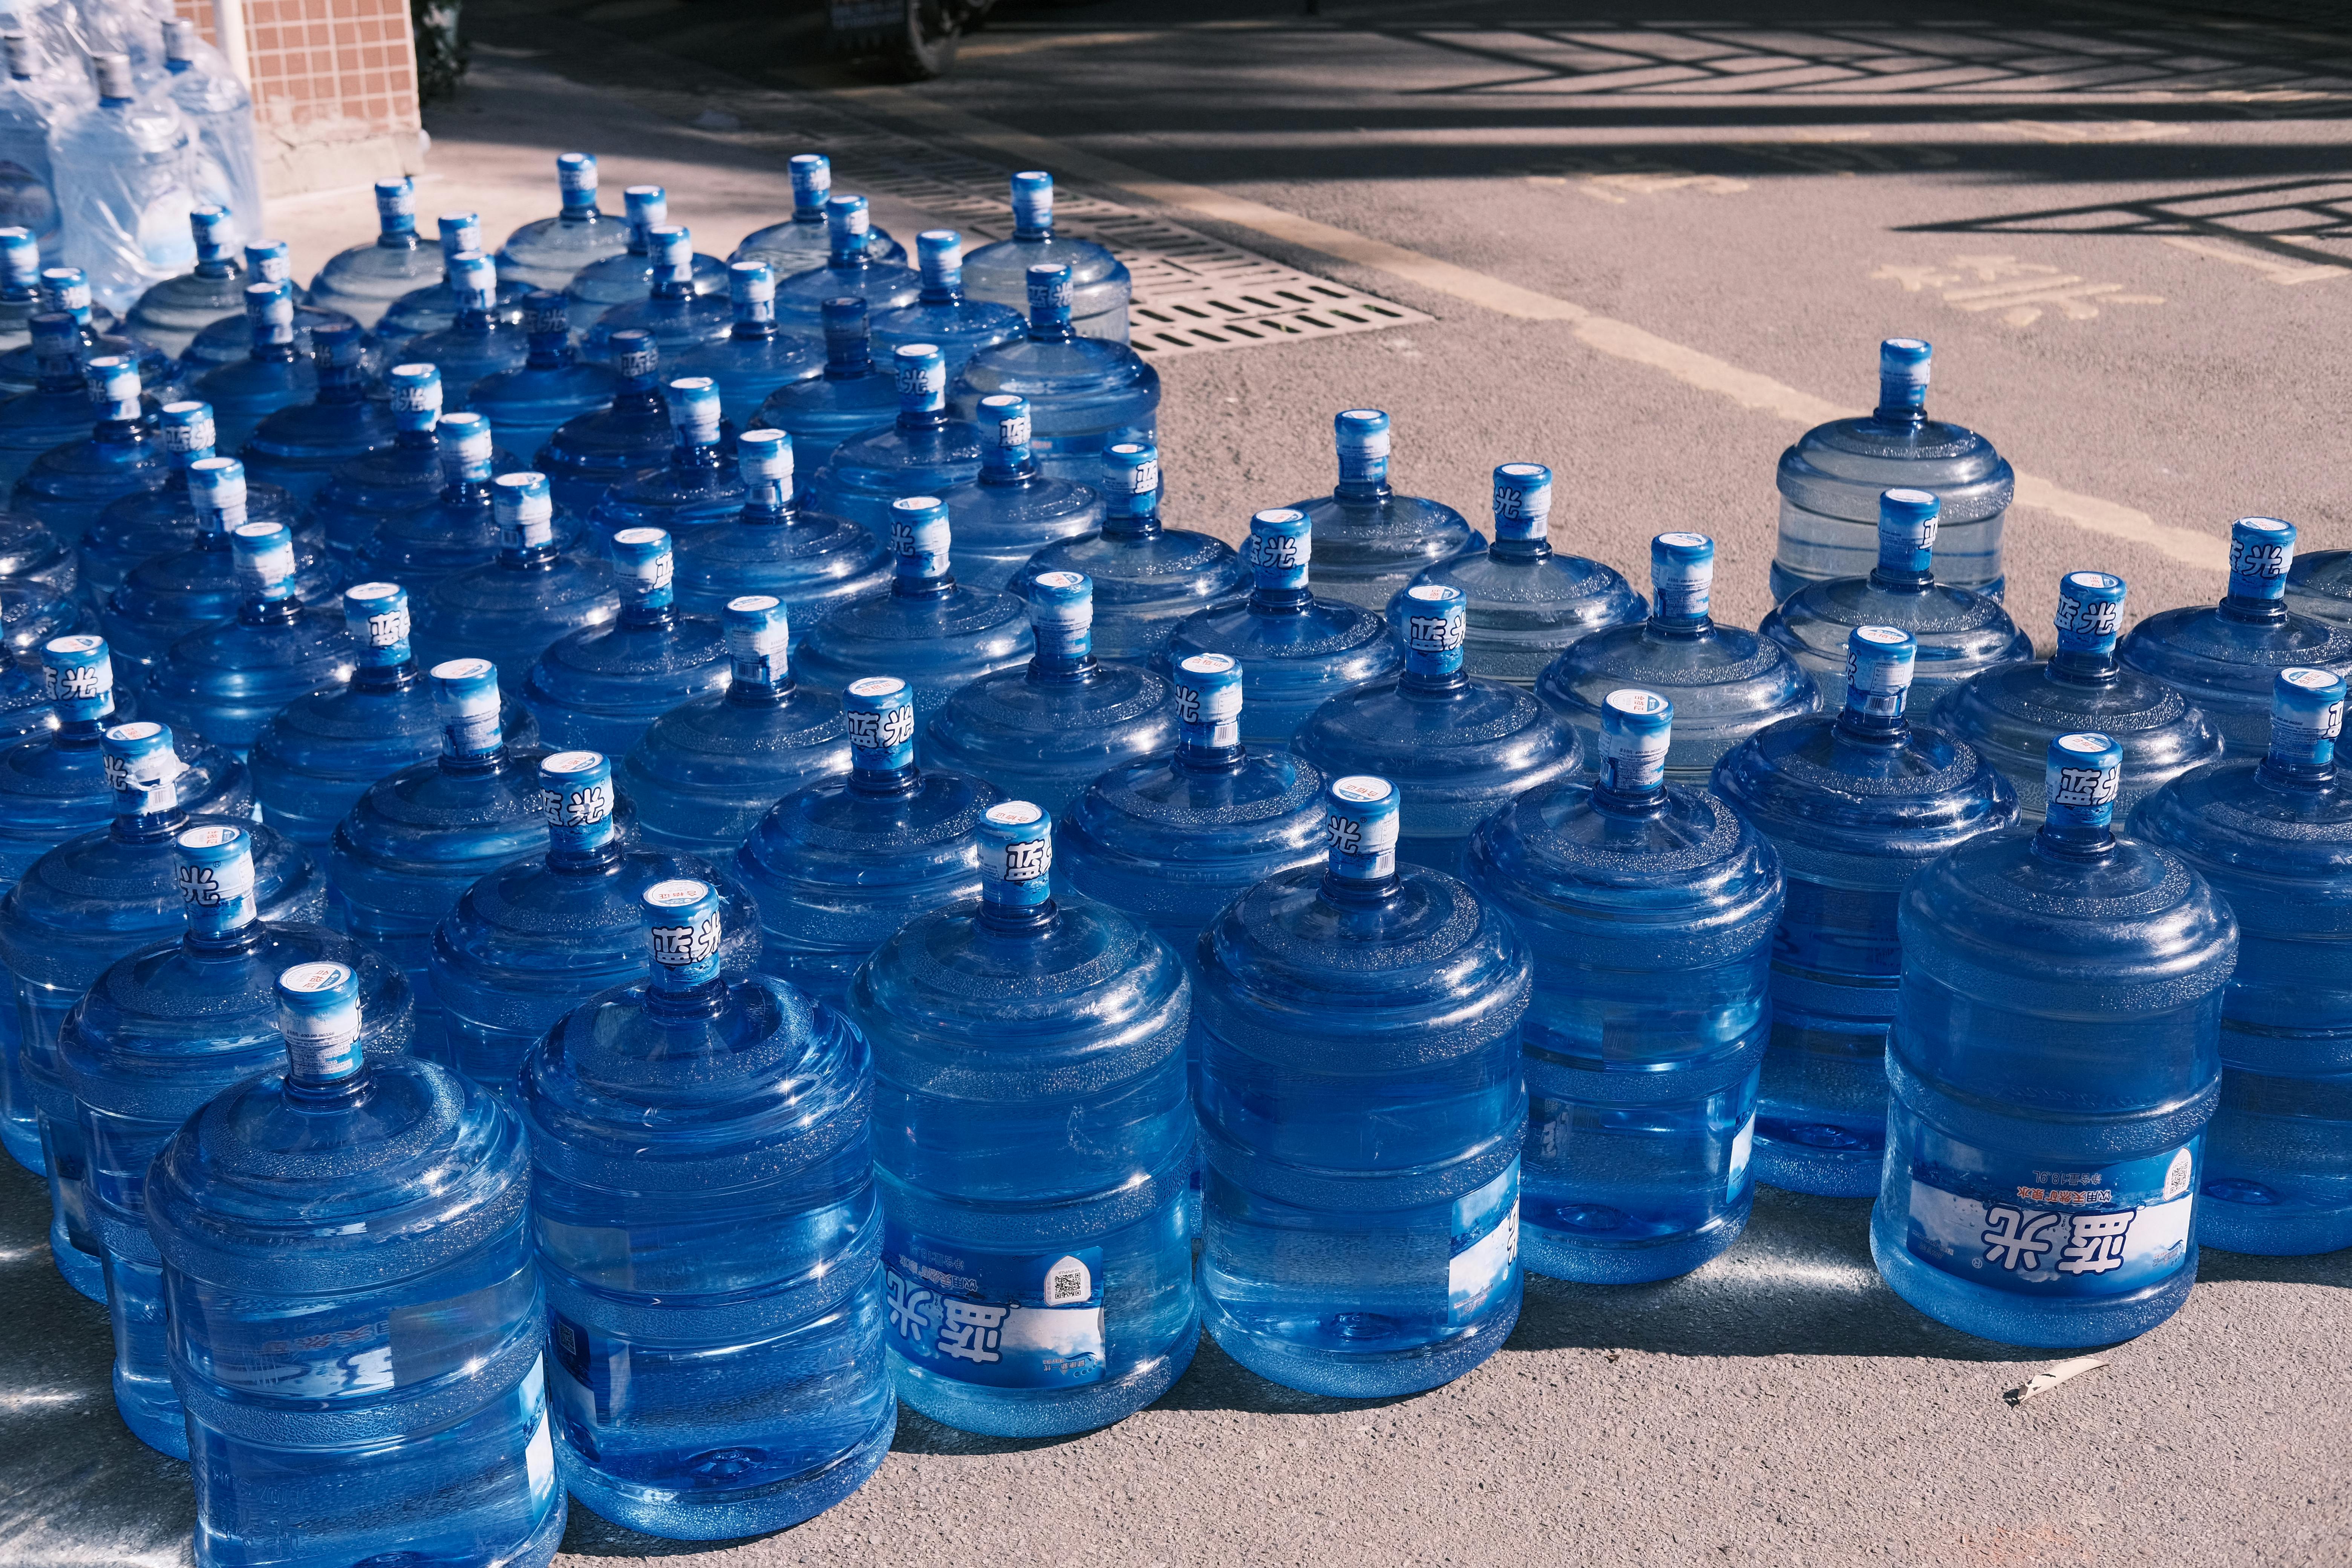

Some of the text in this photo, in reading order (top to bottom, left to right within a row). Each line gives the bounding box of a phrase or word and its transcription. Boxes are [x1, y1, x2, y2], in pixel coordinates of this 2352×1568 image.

[1192, 658, 1224, 667] 合格证
[848, 705, 913, 748] 蓝光
[2017, 1186, 2112, 1203] 饮用天然矿泉水
[1981, 1204, 2137, 1277] 蓝光
[899, 1254, 978, 1292] 饮用天然矿泉水
[885, 1268, 1010, 1366] 蓝光
[1043, 1359, 1086, 1372] 健康新一代
